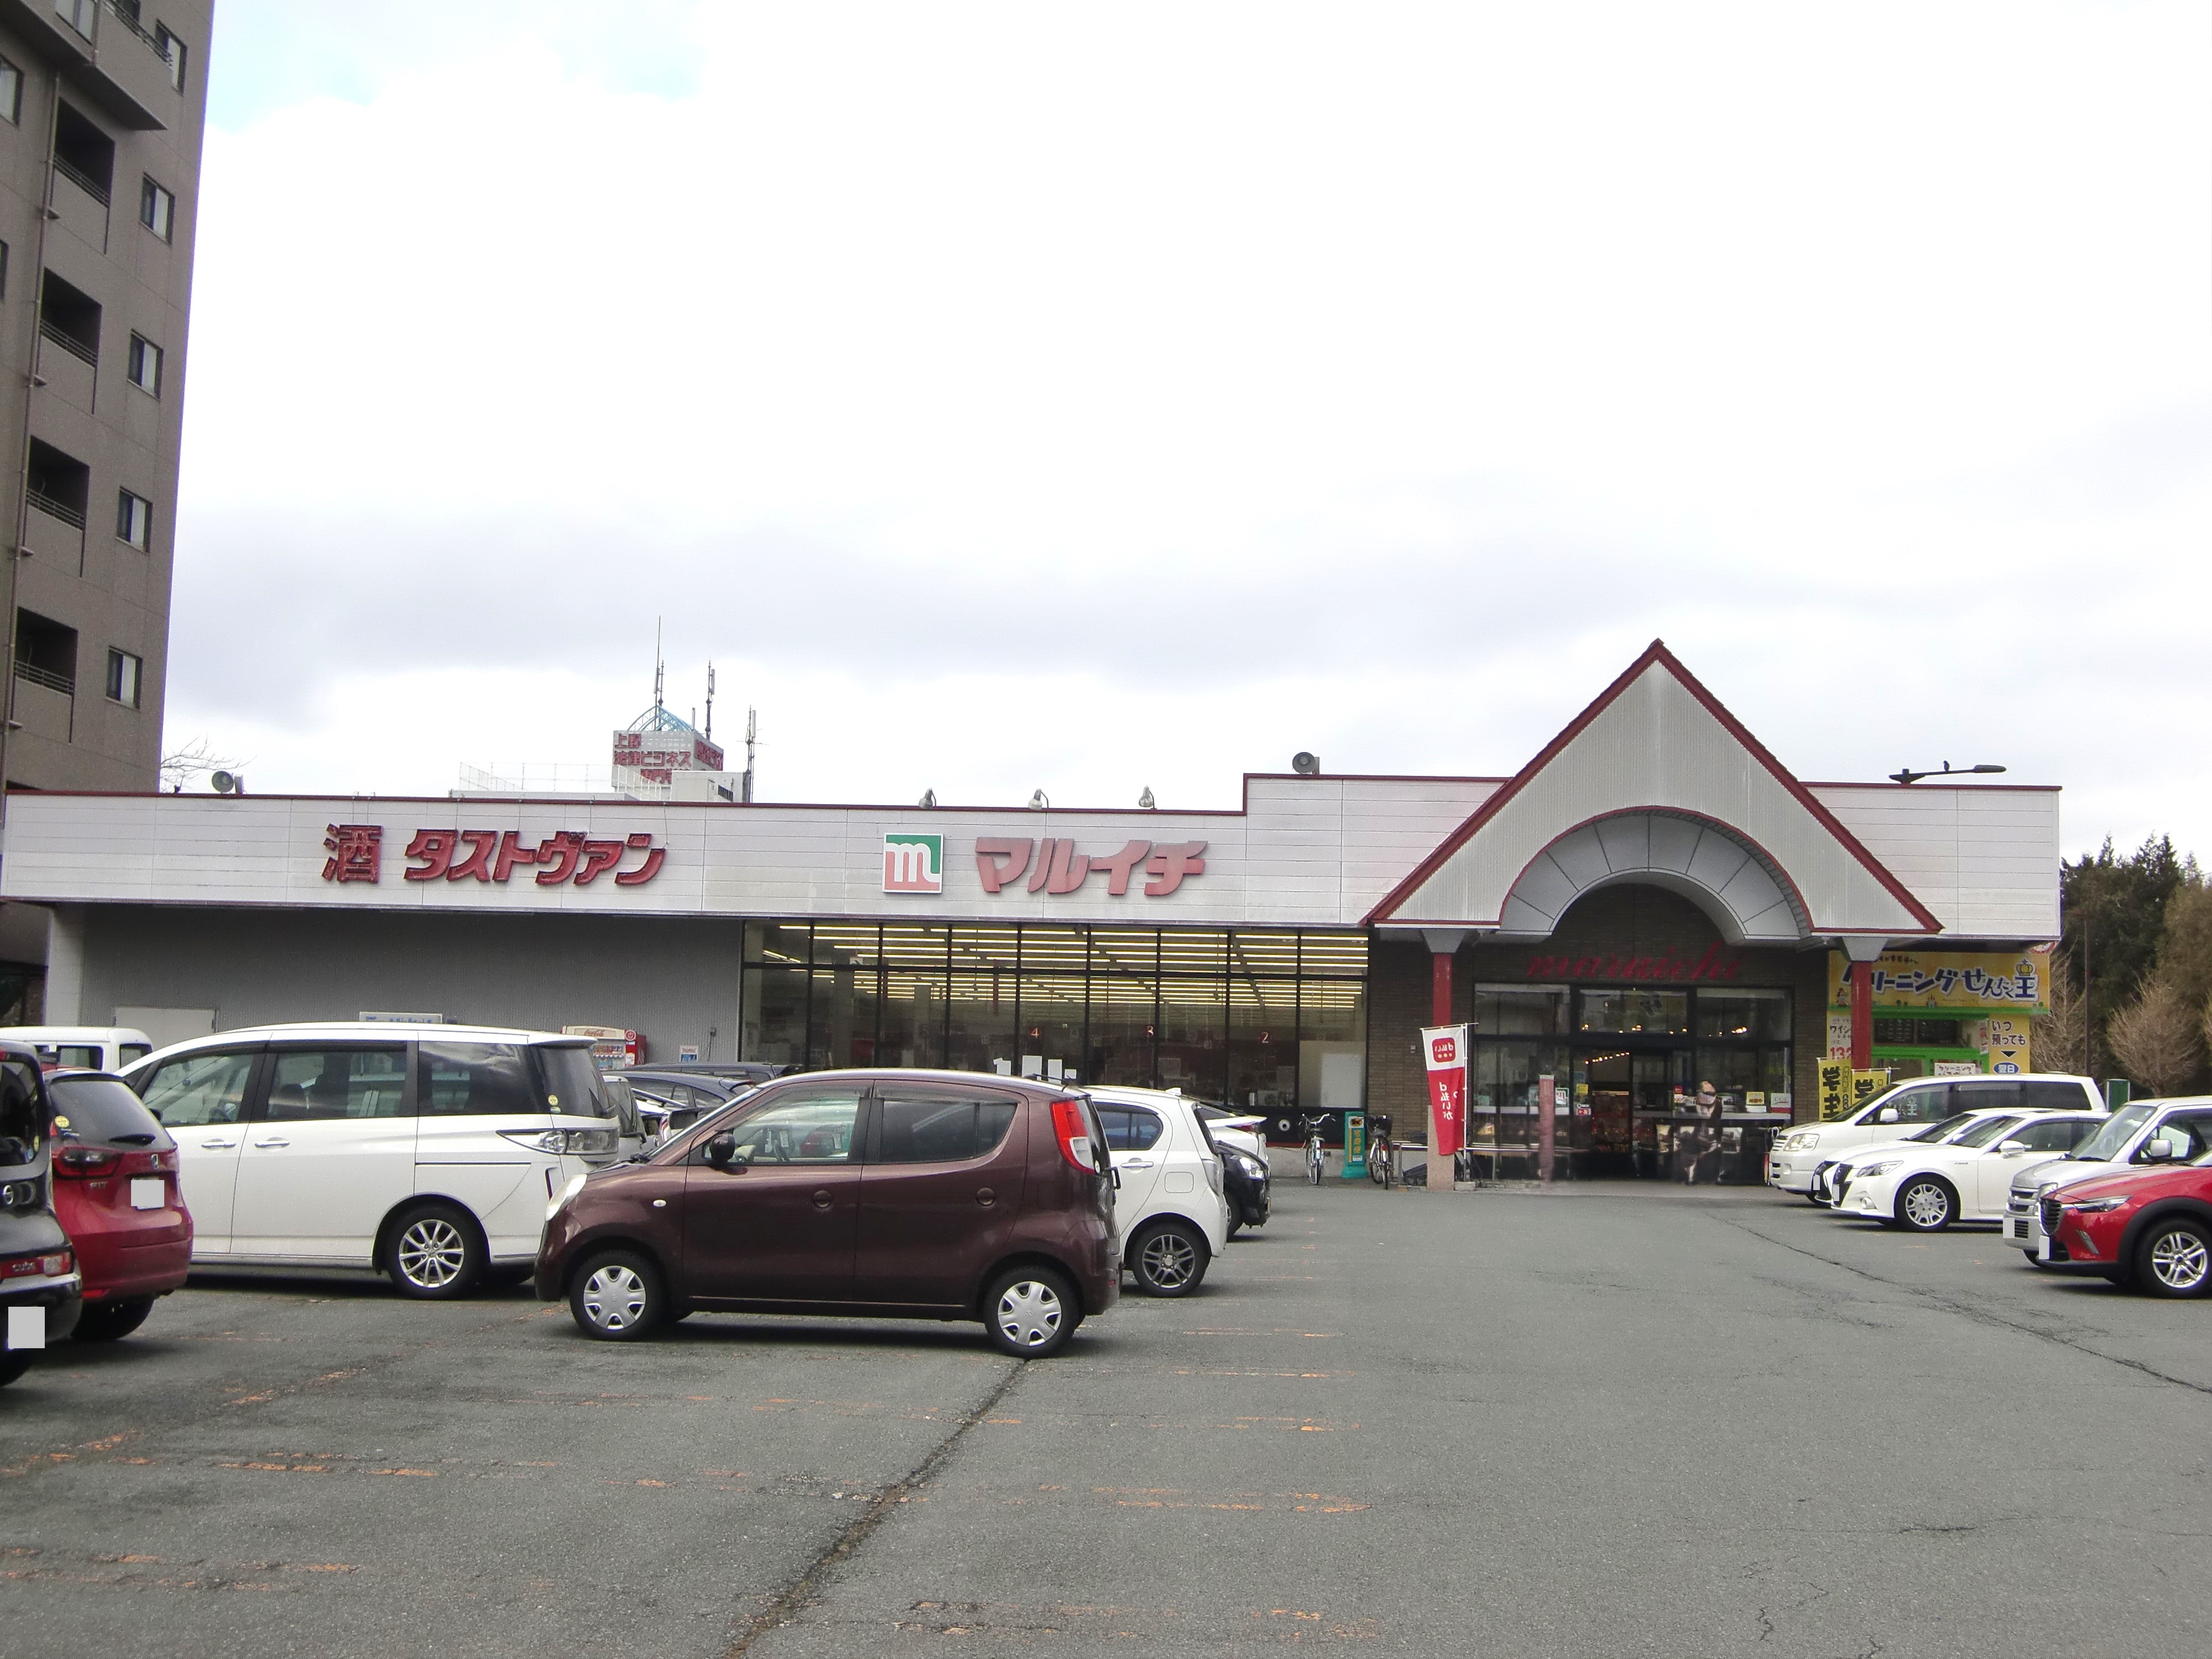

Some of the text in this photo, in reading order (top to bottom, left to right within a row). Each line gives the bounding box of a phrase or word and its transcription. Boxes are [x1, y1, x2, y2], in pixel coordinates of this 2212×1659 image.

[614, 733, 641, 748] 上野
[321, 823, 666, 885] 酒 タストヴァン
[974, 837, 1208, 896] マルイチ
[1992, 1021, 2012, 1031] いつ
[1030, 1027, 1040, 1039] 4
[1261, 1031, 1269, 1044] 2
[1992, 1034, 2026, 1046] 預っても
